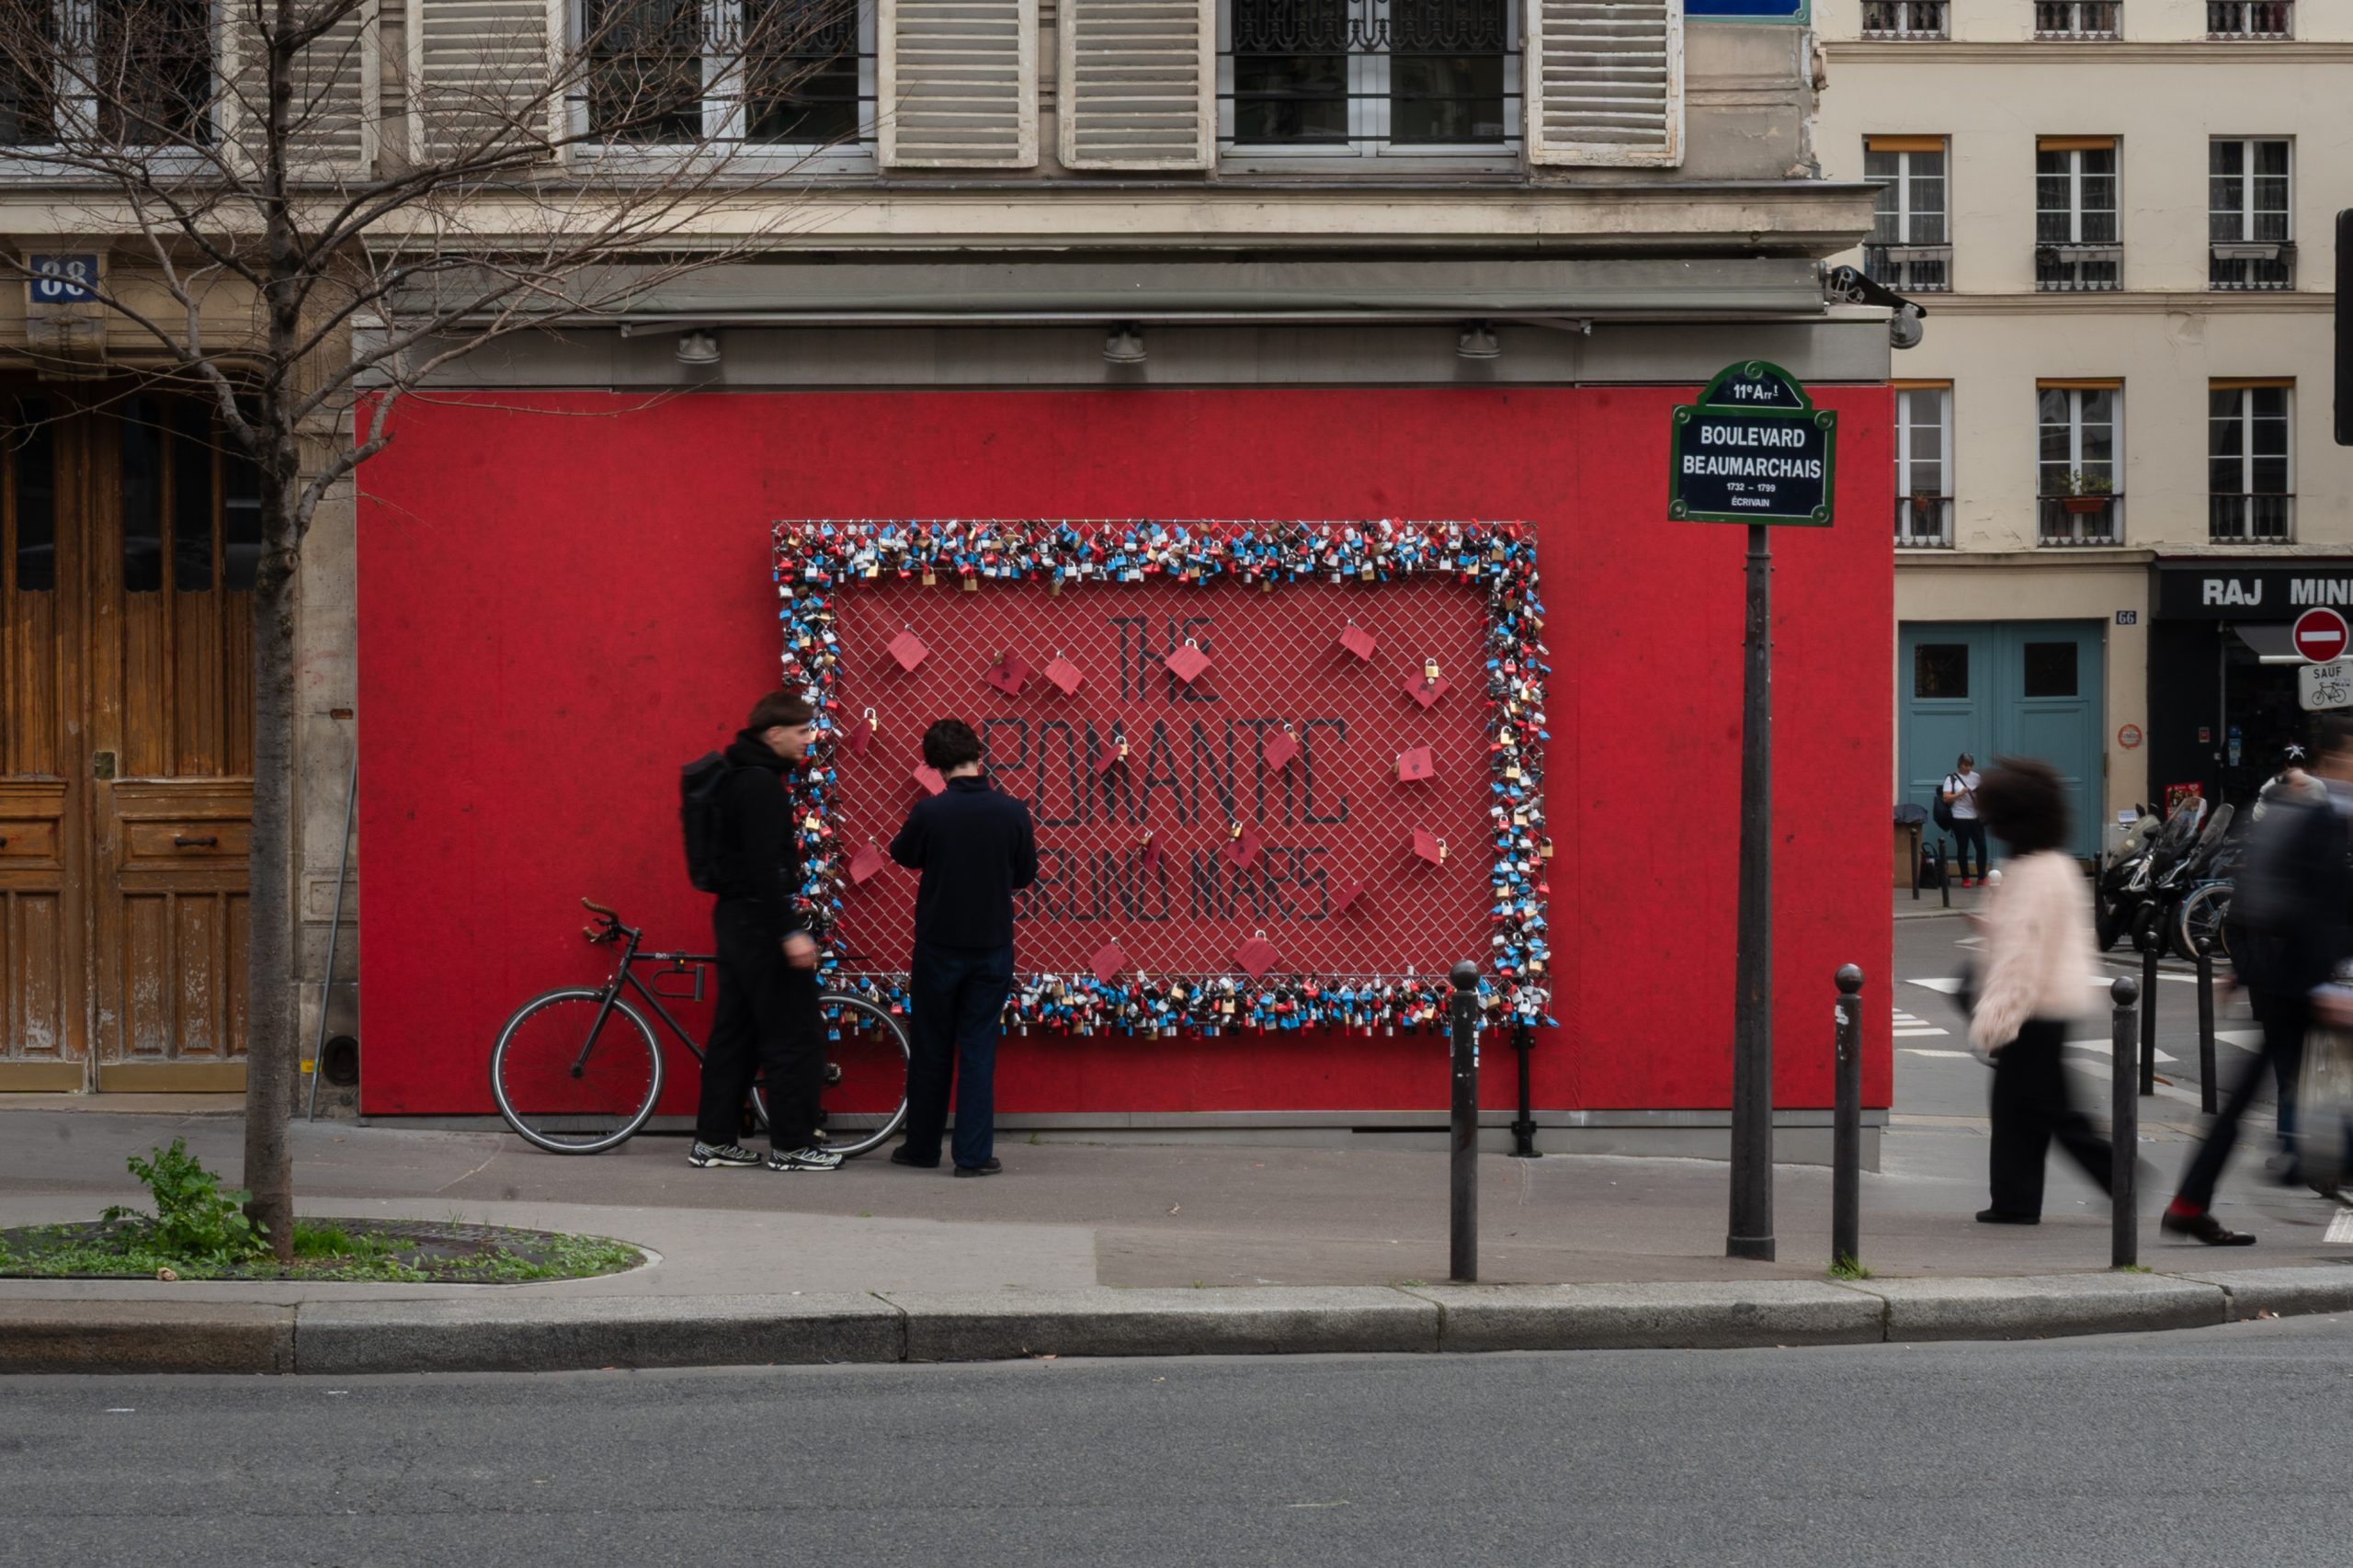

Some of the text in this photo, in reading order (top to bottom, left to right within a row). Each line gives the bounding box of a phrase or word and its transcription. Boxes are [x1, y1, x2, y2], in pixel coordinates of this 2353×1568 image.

[41, 261, 85, 295] 88
[1701, 426, 1805, 448] BOULEVARD
[1683, 455, 1821, 478] BEAUMARCHAIS
[1726, 483, 1745, 491] 1732
[1757, 483, 1776, 492] 1799
[1731, 495, 1769, 506] ÉCRIVAIN
[2203, 579, 2262, 605] RAJ
[2119, 612, 2134, 624] 66
[1107, 617, 1221, 704] THE
[2313, 666, 2342, 679] SAUF
[983, 718, 1349, 826] ROMANTIC
[1191, 847, 1329, 921] MARS
